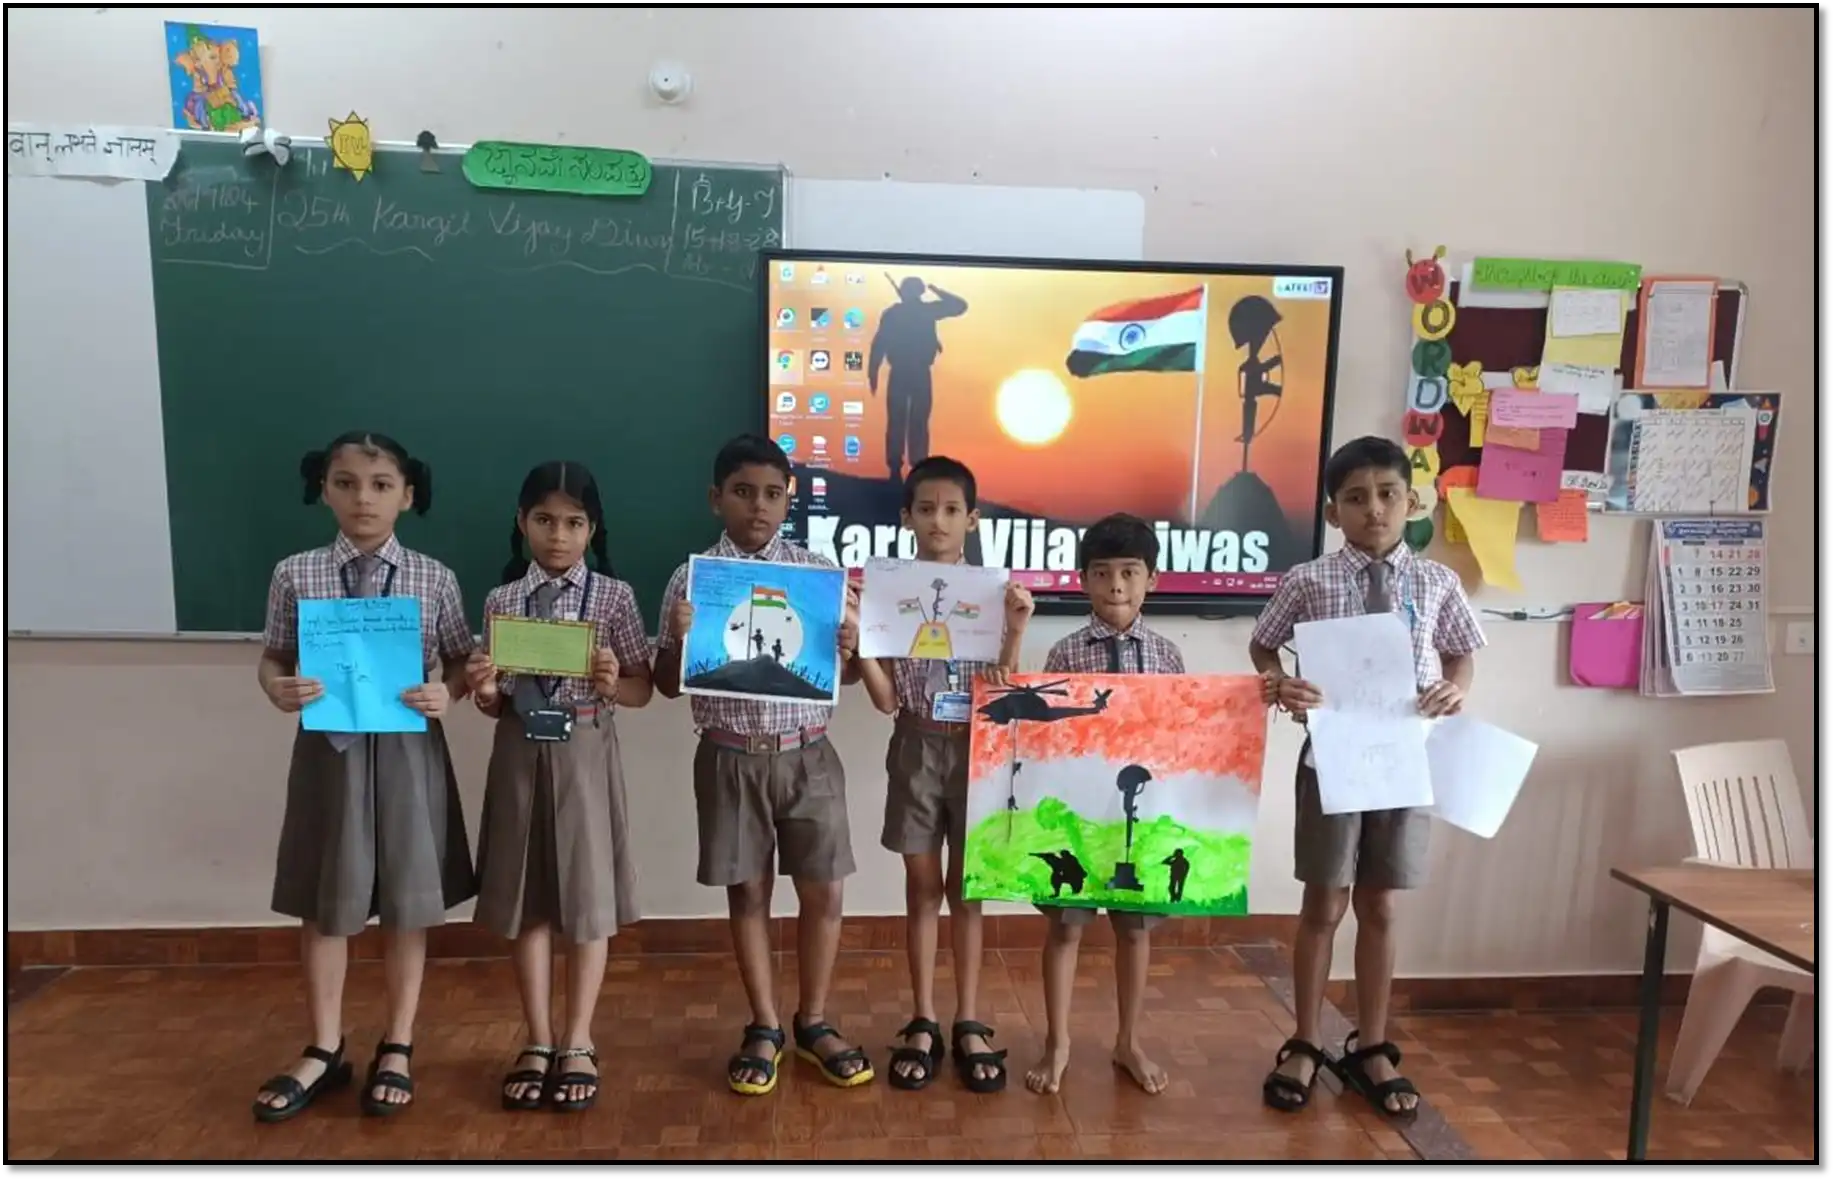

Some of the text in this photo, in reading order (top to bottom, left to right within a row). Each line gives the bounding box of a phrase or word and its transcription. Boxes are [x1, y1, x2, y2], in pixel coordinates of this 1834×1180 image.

[277, 191, 350, 229] 25th
[372, 194, 469, 246] Kargil
[488, 200, 572, 258] Vijay
[978, 518, 1090, 571] Vija
[1710, 567, 1723, 576] 15
[1728, 567, 1742, 576] 22
[1747, 567, 1760, 576] 29
[1711, 584, 1724, 593] 16
[1729, 584, 1742, 593] 23
[1711, 601, 1723, 610] 17
[1729, 602, 1742, 610] 24
